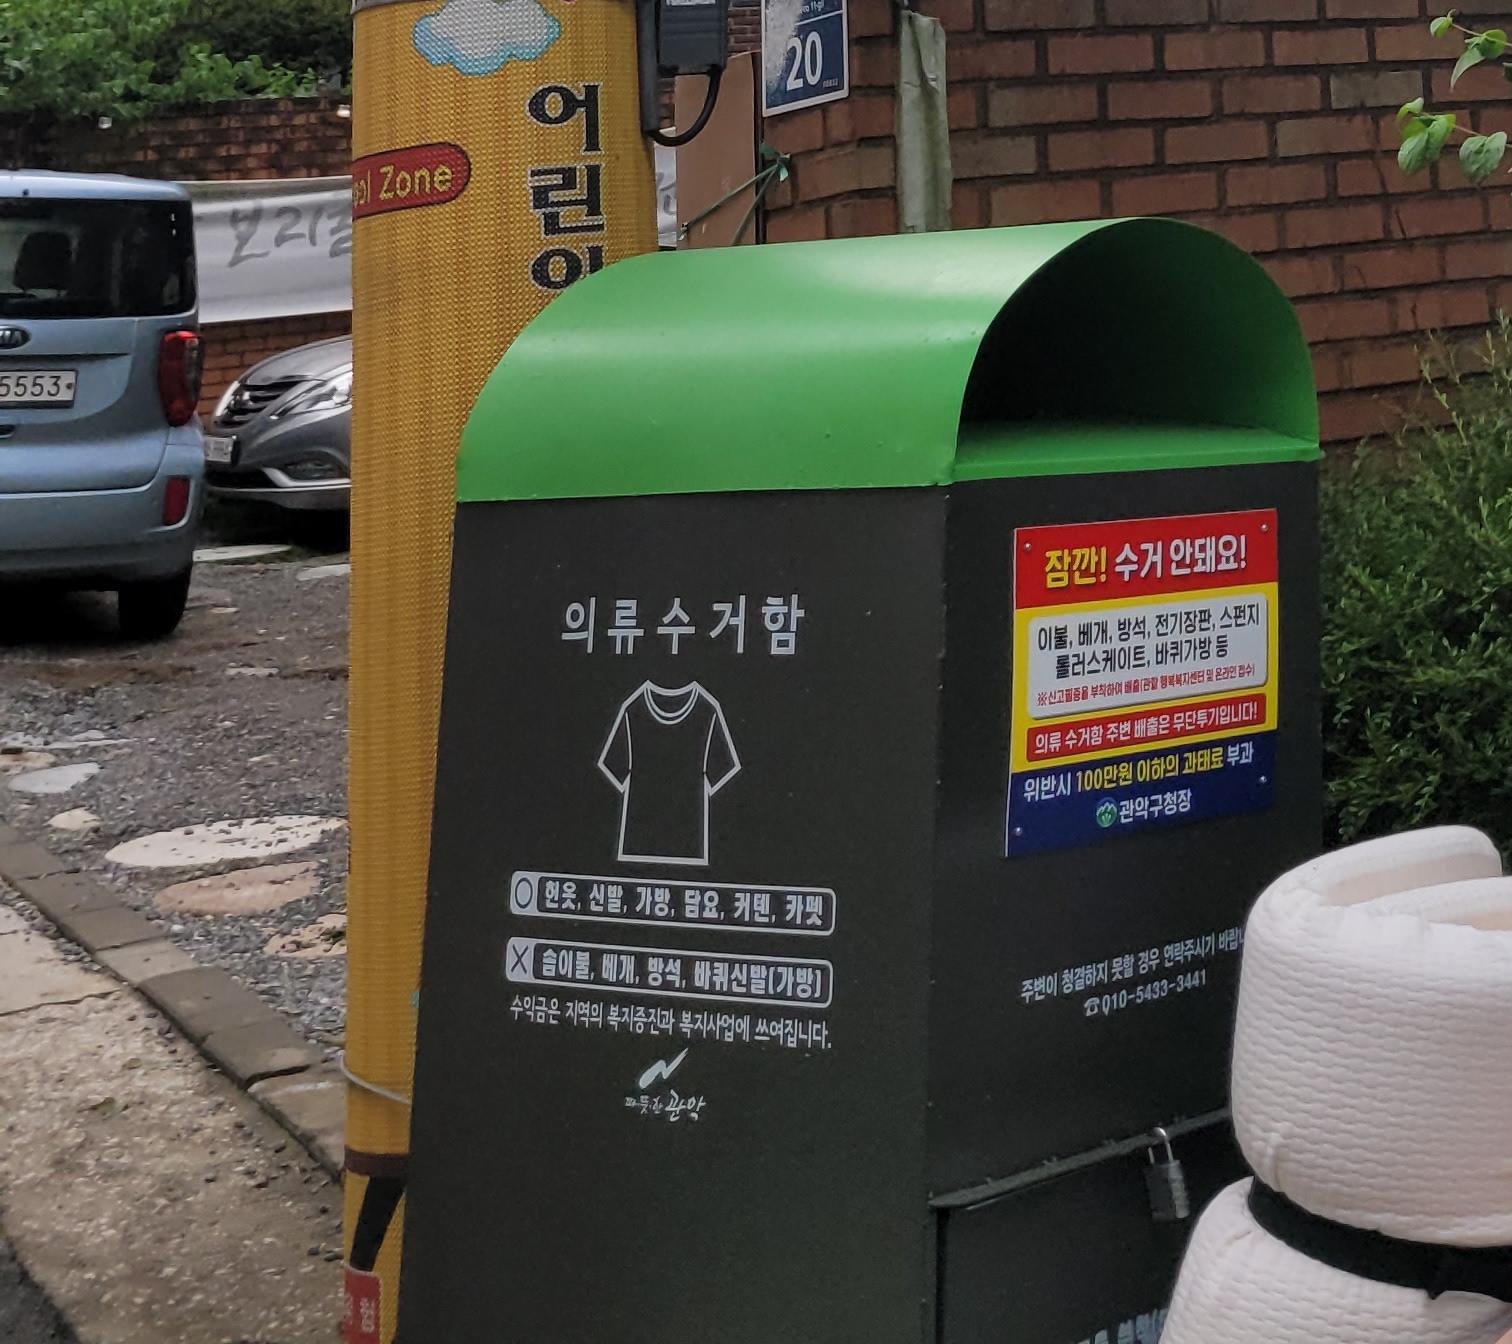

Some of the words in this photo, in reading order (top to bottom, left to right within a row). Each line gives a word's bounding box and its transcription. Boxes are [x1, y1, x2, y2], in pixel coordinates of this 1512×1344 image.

[786, 30, 824, 92] 20
[379, 163, 454, 201] Zone
[528, 82, 605, 291] 어린이
[1044, 544, 1108, 590] 잠깐!
[1114, 539, 1164, 583] 수거
[1169, 534, 1247, 577] 안돼요!
[561, 593, 805, 656] 의류수거함
[1038, 623, 1074, 652] 이불,
[1078, 619, 1113, 648] 베개,
[1117, 614, 1151, 642] 방석,
[1155, 608, 1216, 638] 전기장판,
[1219, 602, 1260, 630] 스펀지
[1055, 643, 1151, 680] 롤러스케이트,
[1154, 634, 1212, 667] 바퀴가방
[1215, 634, 1229, 658] 등
[1034, 731, 1062, 755] 의류
[1064, 726, 1104, 751] 수거함
[1106, 721, 1132, 746] 주변
[1134, 715, 1171, 739] 배출은
[1172, 701, 1259, 732] 무단투기입니다!
[1023, 773, 1072, 803] 위반시
[1076, 761, 1134, 791] 100만원
[1136, 754, 1180, 784] 이하의
[1182, 746, 1225, 776] 과태료
[1226, 740, 1255, 767] 부과
[1118, 788, 1194, 824] 관악구청장
[588, 882, 628, 914] 신발,
[634, 885, 676, 918] 가방,
[684, 889, 725, 921] 담요,
[733, 892, 776, 923] 커텐,
[541, 947, 595, 981] 솜이불,
[601, 952, 640, 985] 베개,
[647, 956, 687, 989] 방석,
[1020, 971, 1058, 1005] 주변이
[1061, 959, 1109, 994] 청결하지
[1111, 953, 1135, 982] 못할
[1137, 948, 1161, 975] 경우
[1162, 931, 1216, 968] 연락주시기
[1101, 968, 1207, 1016] 010-5433-3441
[510, 993, 562, 1025] 수익금은
[564, 999, 604, 1029] 지역의
[606, 1002, 676, 1036] 복지증진과
[679, 1010, 751, 1043] 복지사업에
[753, 1017, 832, 1050] 쓰여집니다.
